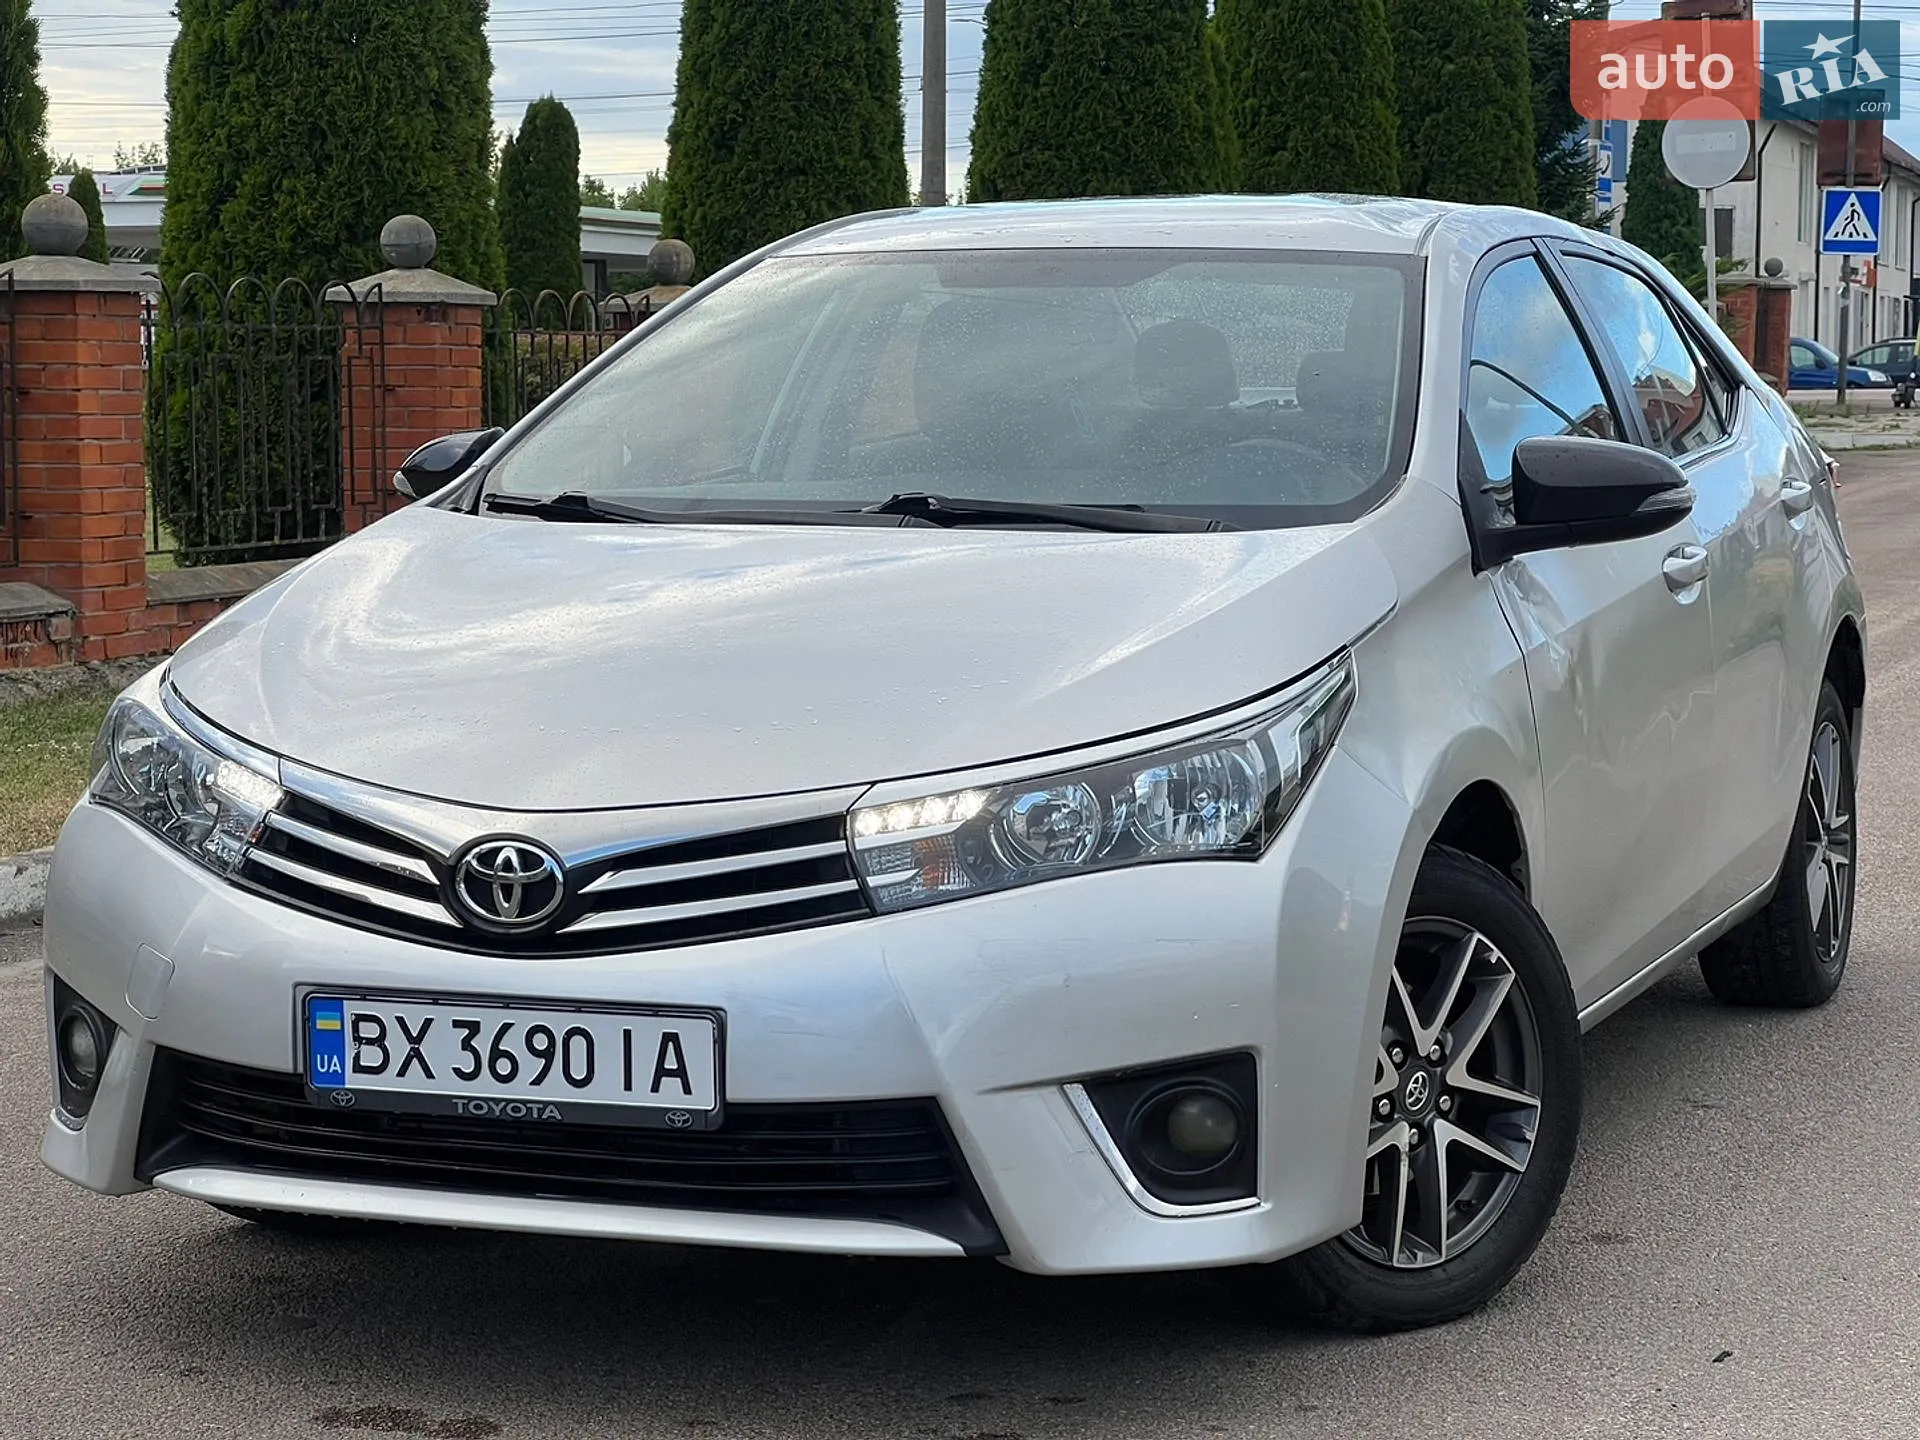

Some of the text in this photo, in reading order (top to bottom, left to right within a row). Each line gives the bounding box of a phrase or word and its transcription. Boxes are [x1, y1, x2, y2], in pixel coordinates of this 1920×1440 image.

[316, 1054, 342, 1074] UA
[350, 1012, 693, 1096] BX 3690 IA
[451, 1097, 563, 1122] TOYOTA
